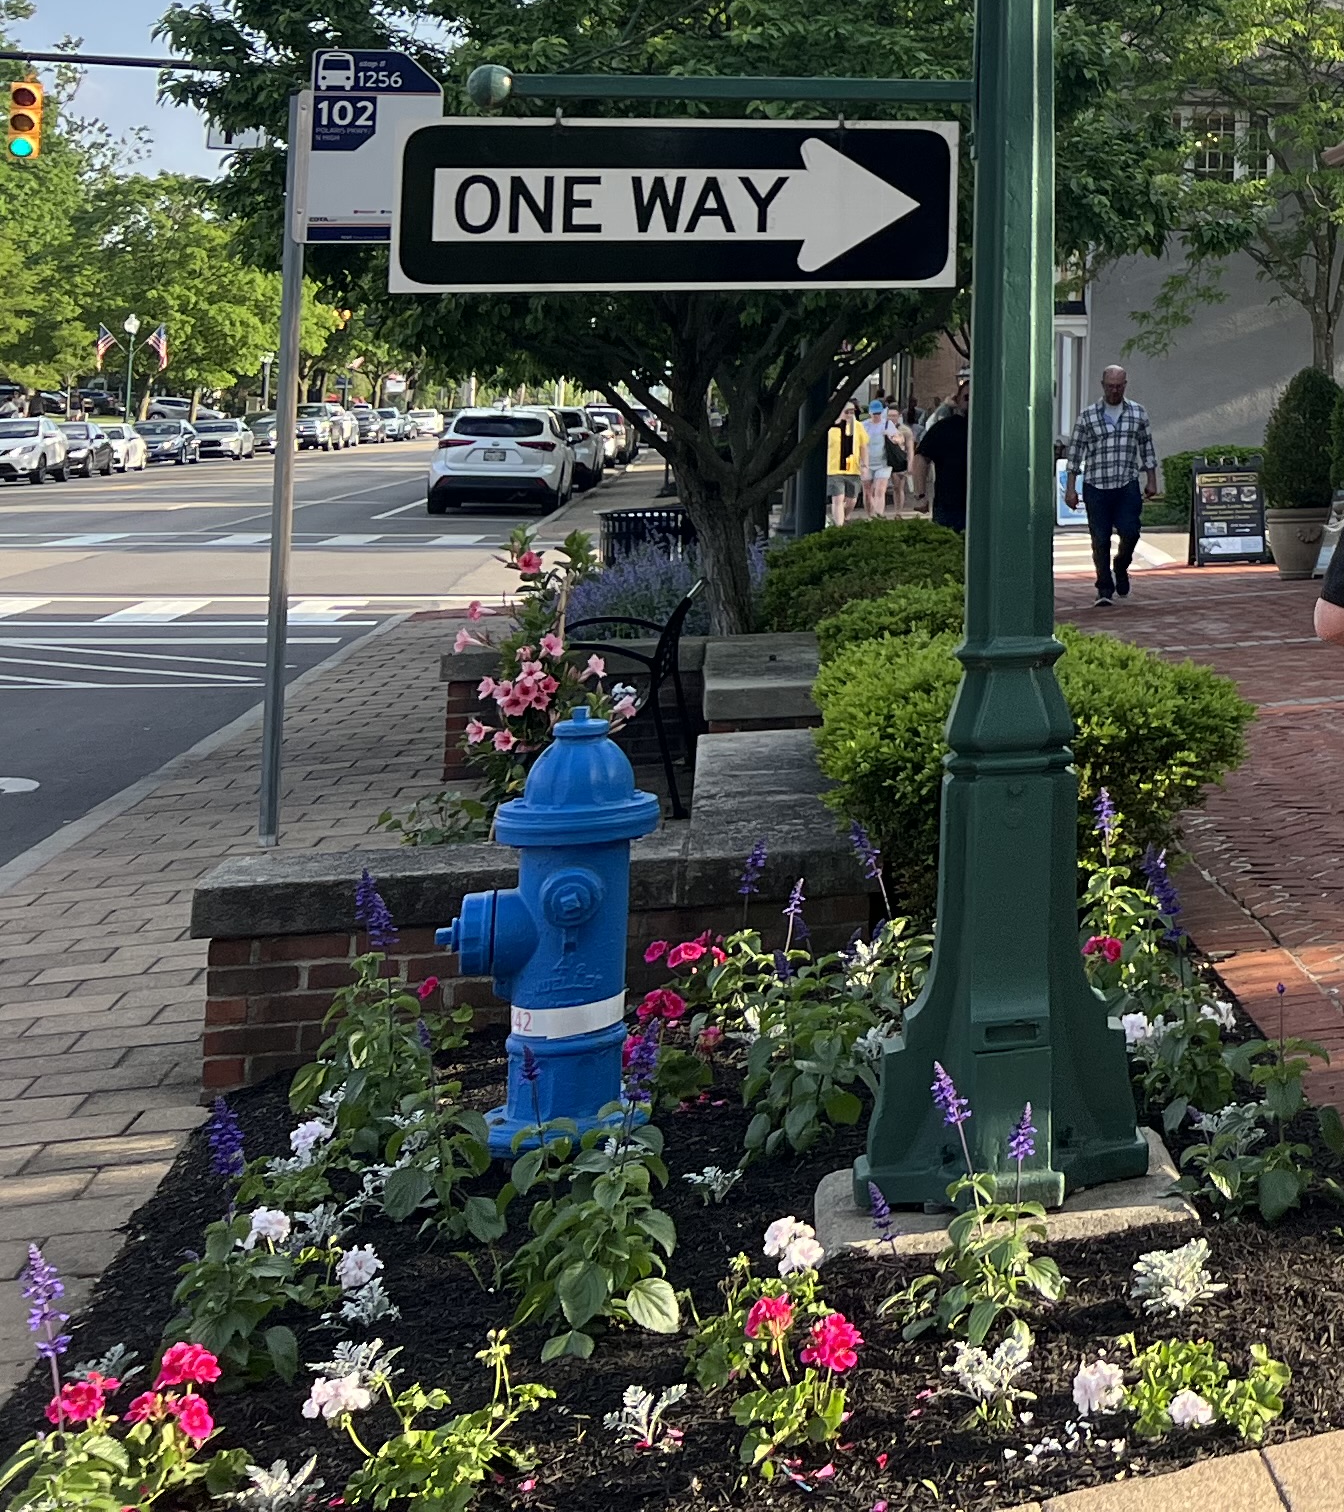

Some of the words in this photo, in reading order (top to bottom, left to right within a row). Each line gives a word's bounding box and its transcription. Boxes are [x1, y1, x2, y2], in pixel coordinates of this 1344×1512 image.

[357, 71, 403, 87] 1256
[317, 100, 374, 126] 102
[455, 174, 602, 234] ONE
[631, 176, 790, 233] WAY
[511, 1010, 533, 1033] 42
